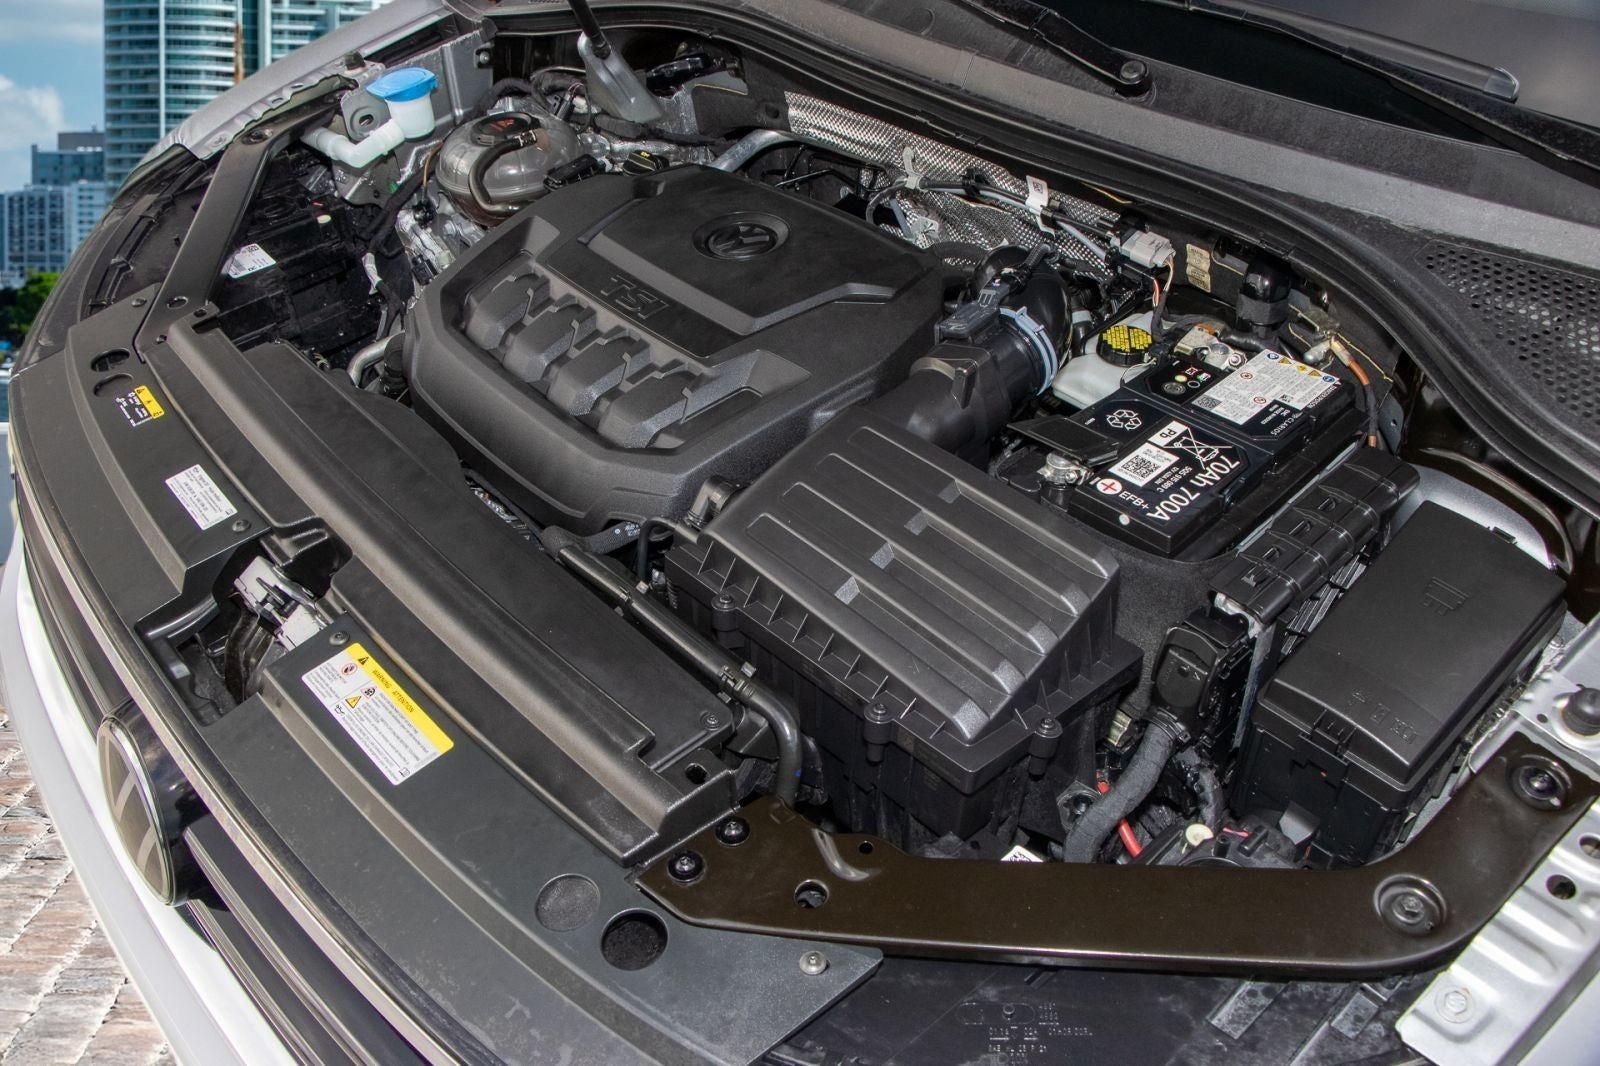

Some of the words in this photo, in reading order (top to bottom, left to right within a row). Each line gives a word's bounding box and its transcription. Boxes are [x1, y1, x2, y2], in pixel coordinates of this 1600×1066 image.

[600, 275, 669, 320] TSI
[1160, 428, 1177, 439] Pb
[1271, 417, 1295, 436] CLARIOS
[1189, 455, 1240, 487] 70Ah
[1119, 488, 1150, 509] EFB+
[1147, 486, 1200, 521] 700A
[373, 669, 392, 688] WARNING
[392, 689, 414, 712] ATTENTION
